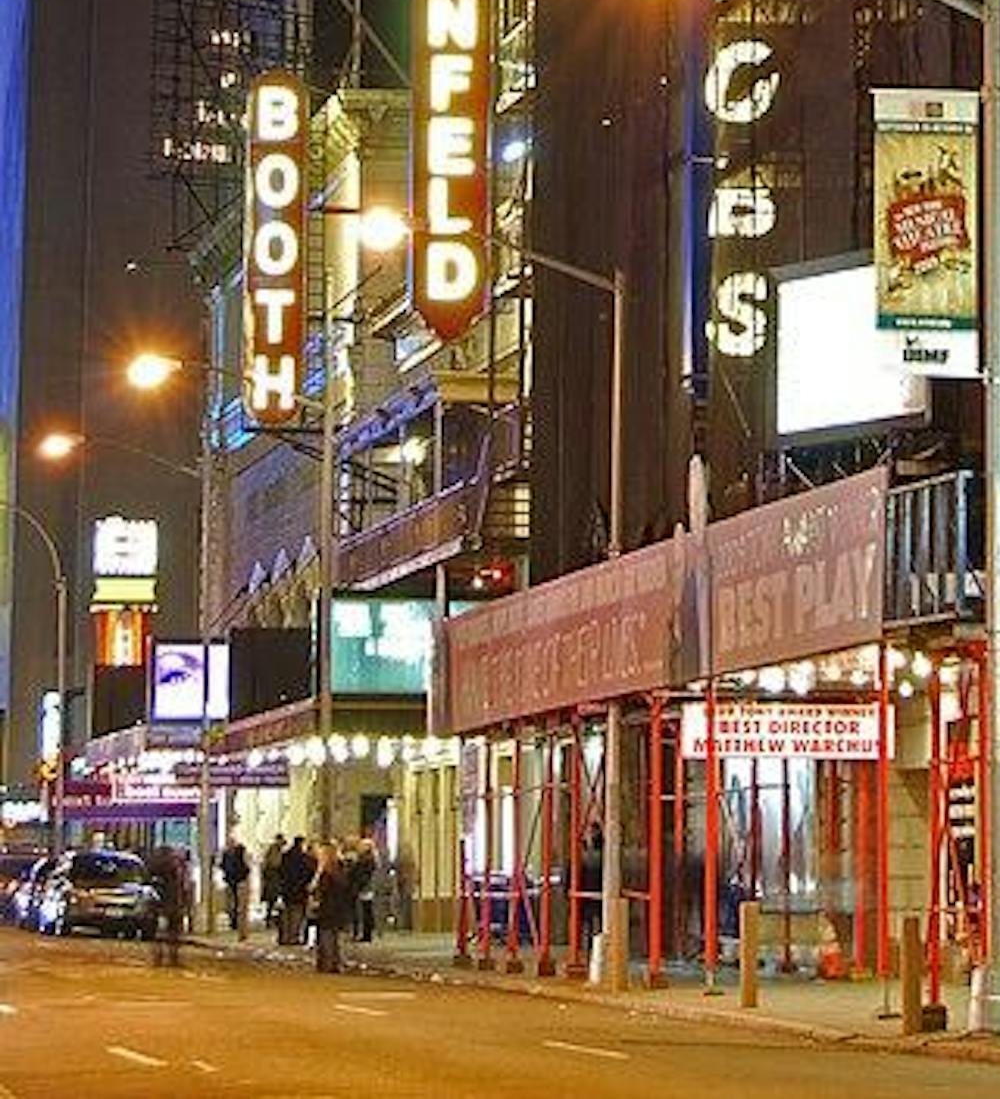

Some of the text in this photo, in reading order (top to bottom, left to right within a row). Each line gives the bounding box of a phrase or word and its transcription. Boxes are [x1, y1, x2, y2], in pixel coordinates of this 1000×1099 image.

[253, 85, 300, 411] BOOTH
[718, 569, 789, 652] BEST
[795, 546, 877, 639] PLAY
[718, 720, 860, 734] BEST DIRECTOR
